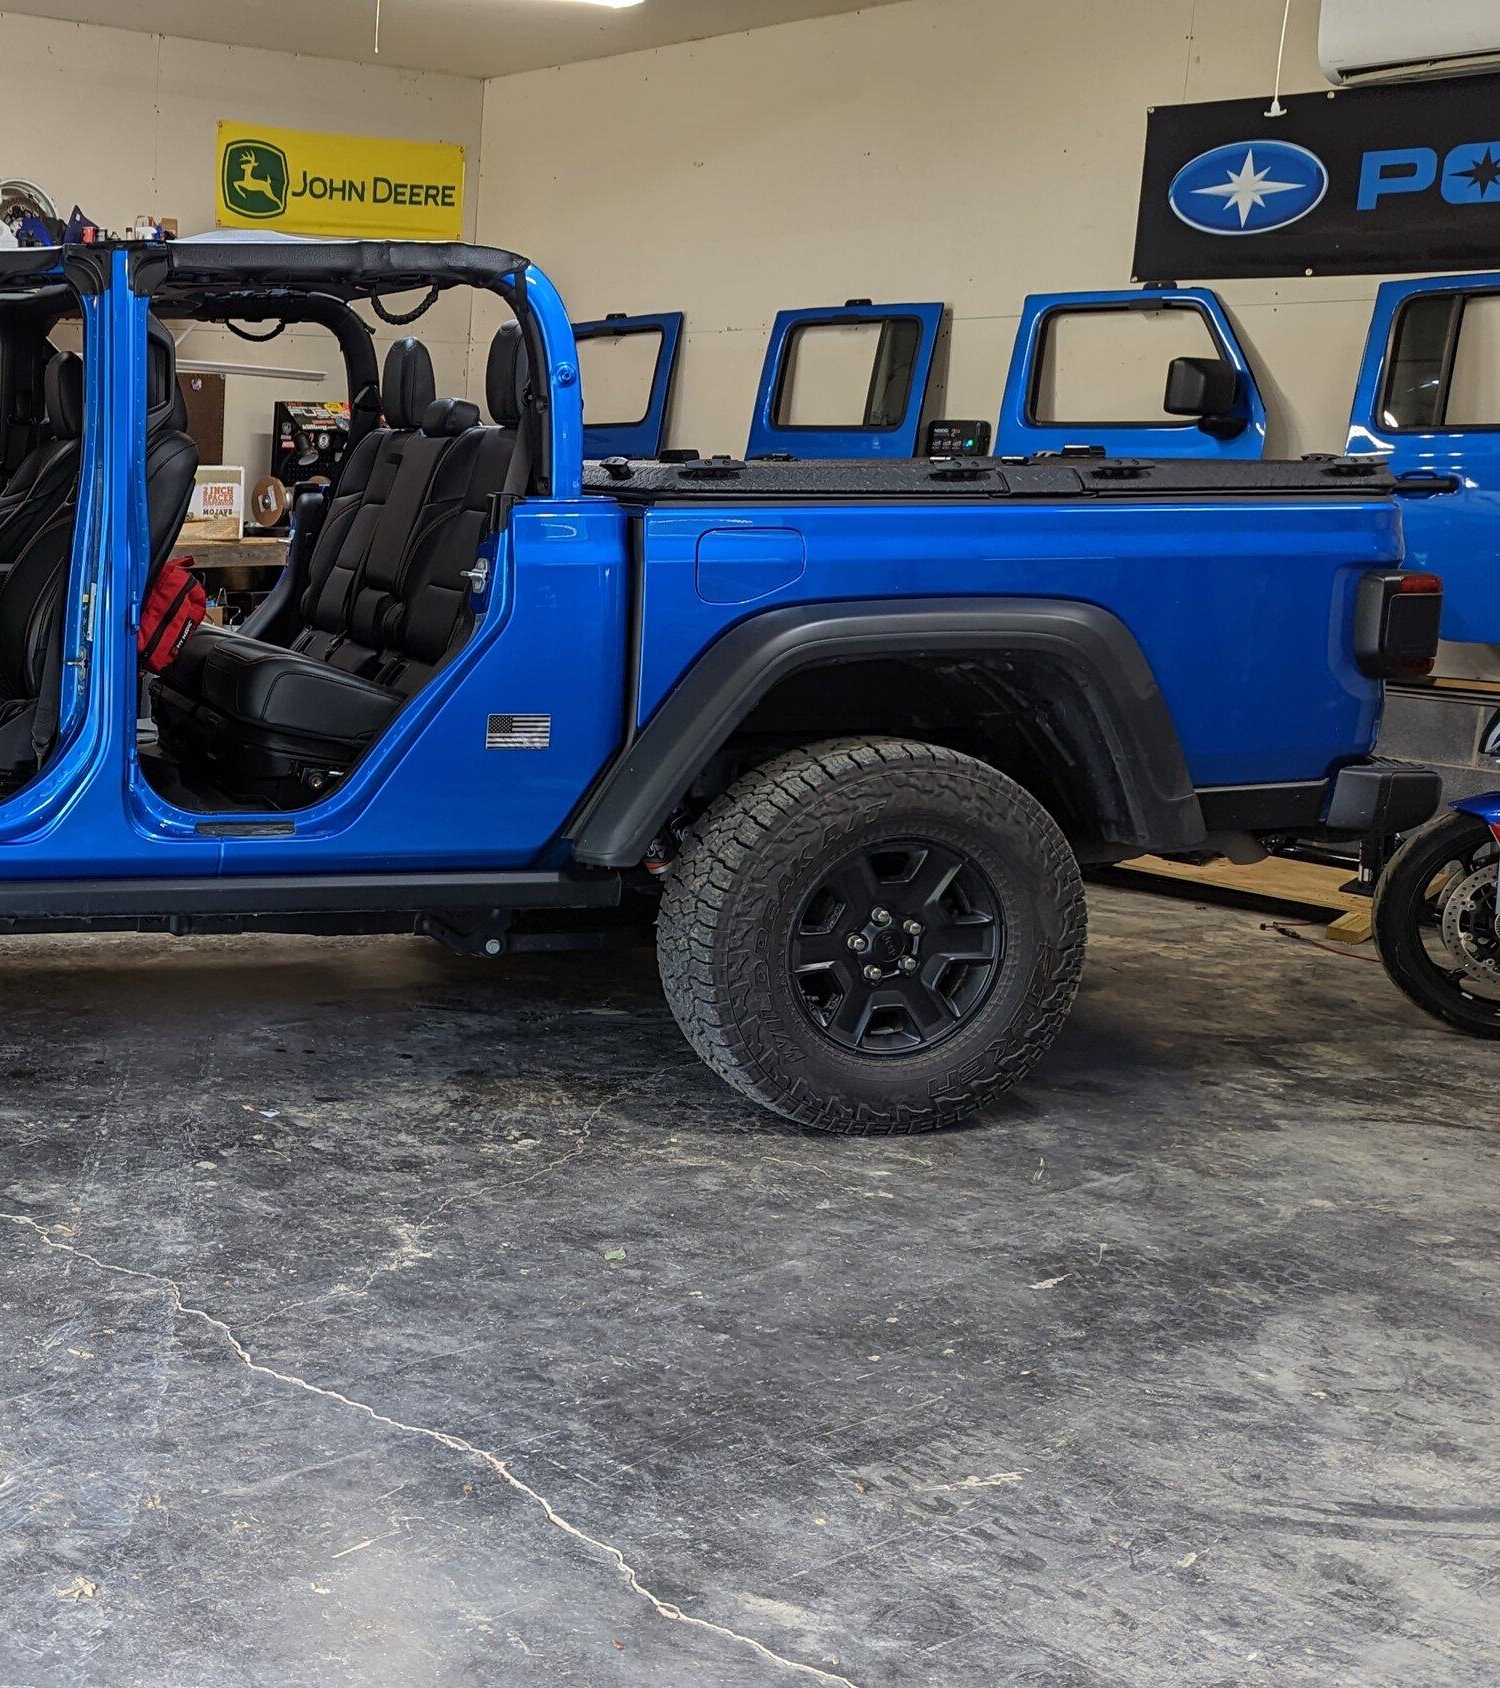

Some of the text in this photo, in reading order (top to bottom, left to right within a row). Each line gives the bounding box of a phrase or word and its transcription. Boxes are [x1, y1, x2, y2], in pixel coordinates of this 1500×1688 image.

[292, 171, 456, 207] JOHN DEERE
[210, 486, 234, 495] INCH
[202, 509, 233, 517] MOJAVE
